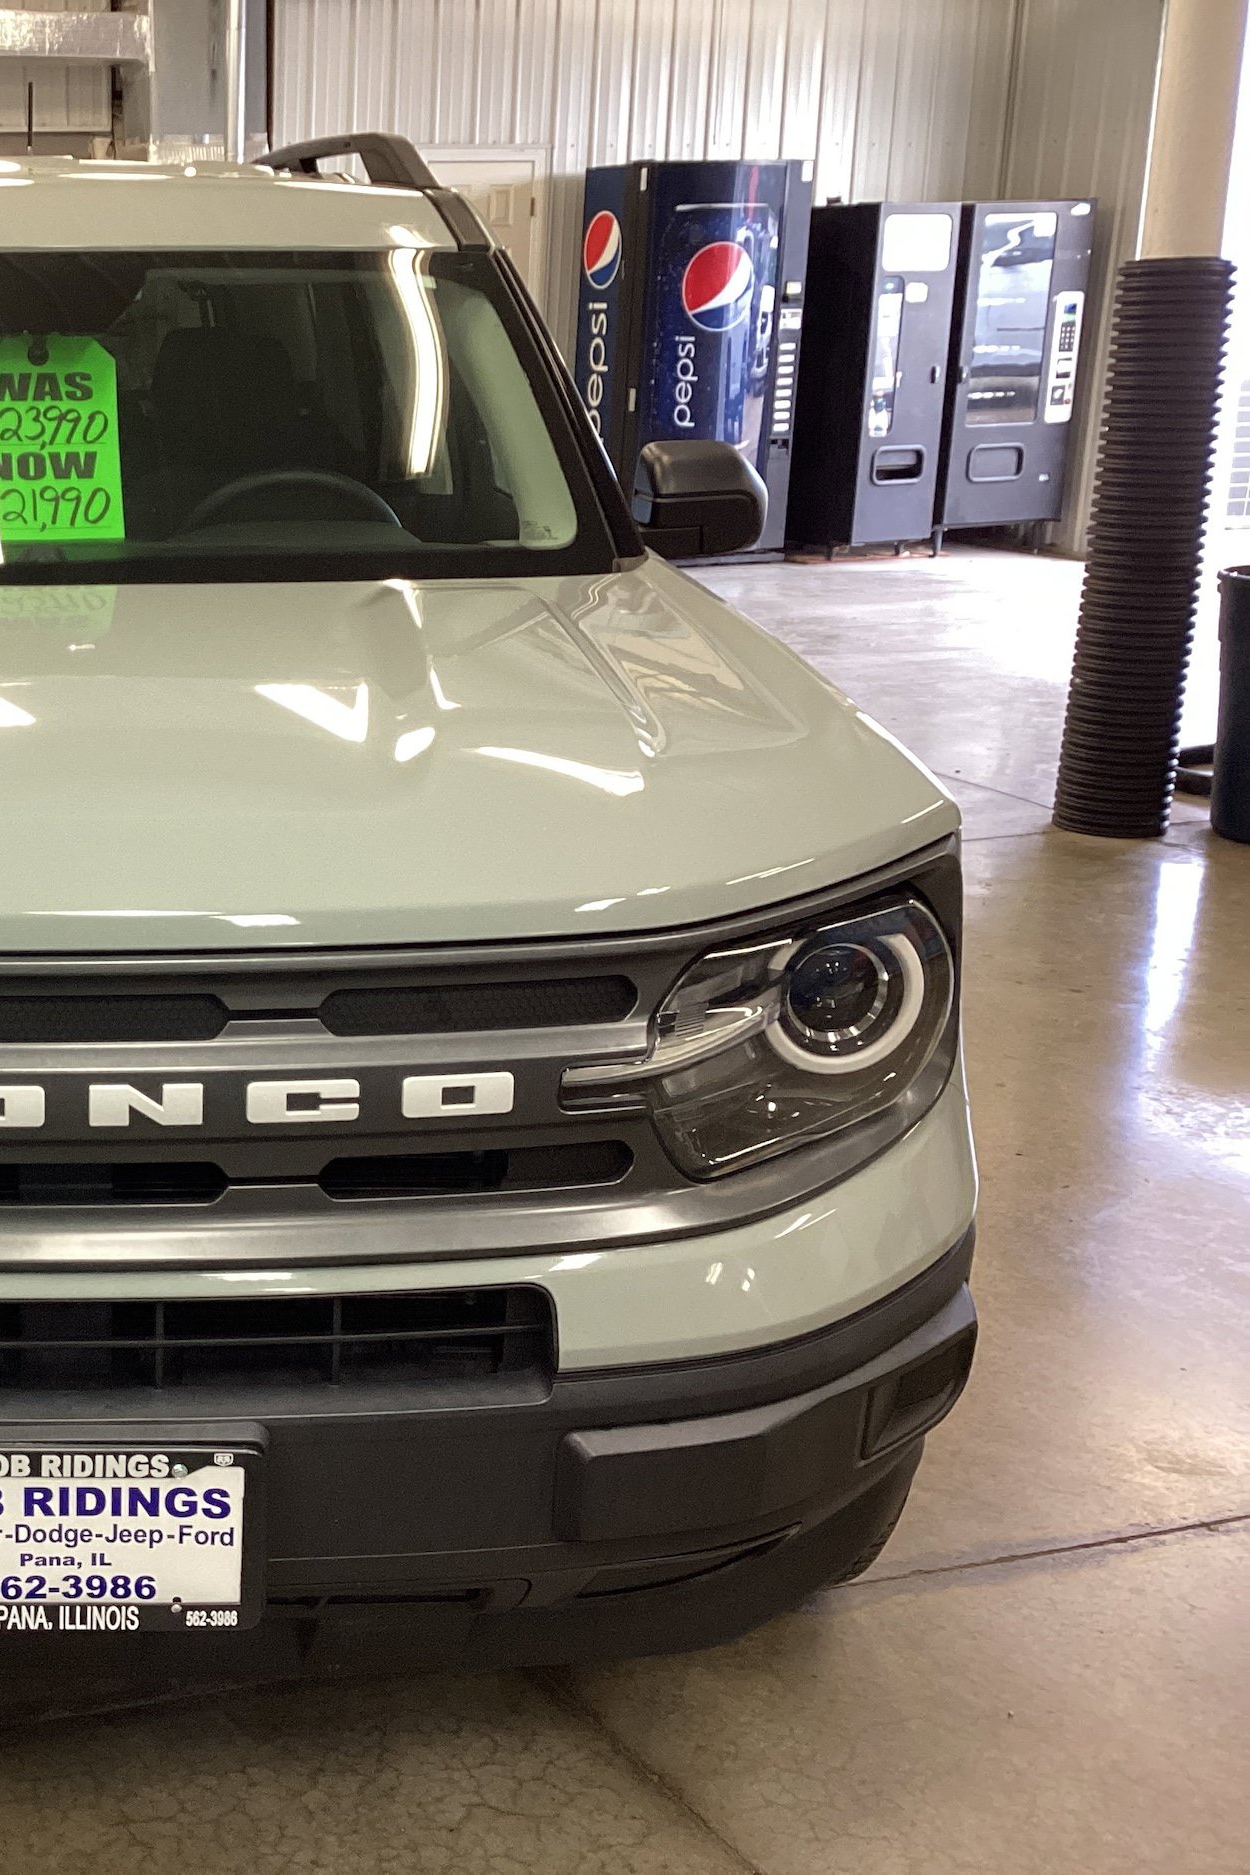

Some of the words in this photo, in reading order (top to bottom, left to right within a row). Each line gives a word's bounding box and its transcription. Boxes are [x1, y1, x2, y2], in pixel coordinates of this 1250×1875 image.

[674, 336, 698, 427] pepsi
[41, 1454, 169, 1477] RIDINGS
[23, 1487, 231, 1518] RIDINGS
[20, 1553, 82, 1569] Pana,
[91, 1553, 112, 1566] IL
[59, 1605, 140, 1631] ILLINOIS
[185, 1610, 238, 1627] 562-3986
